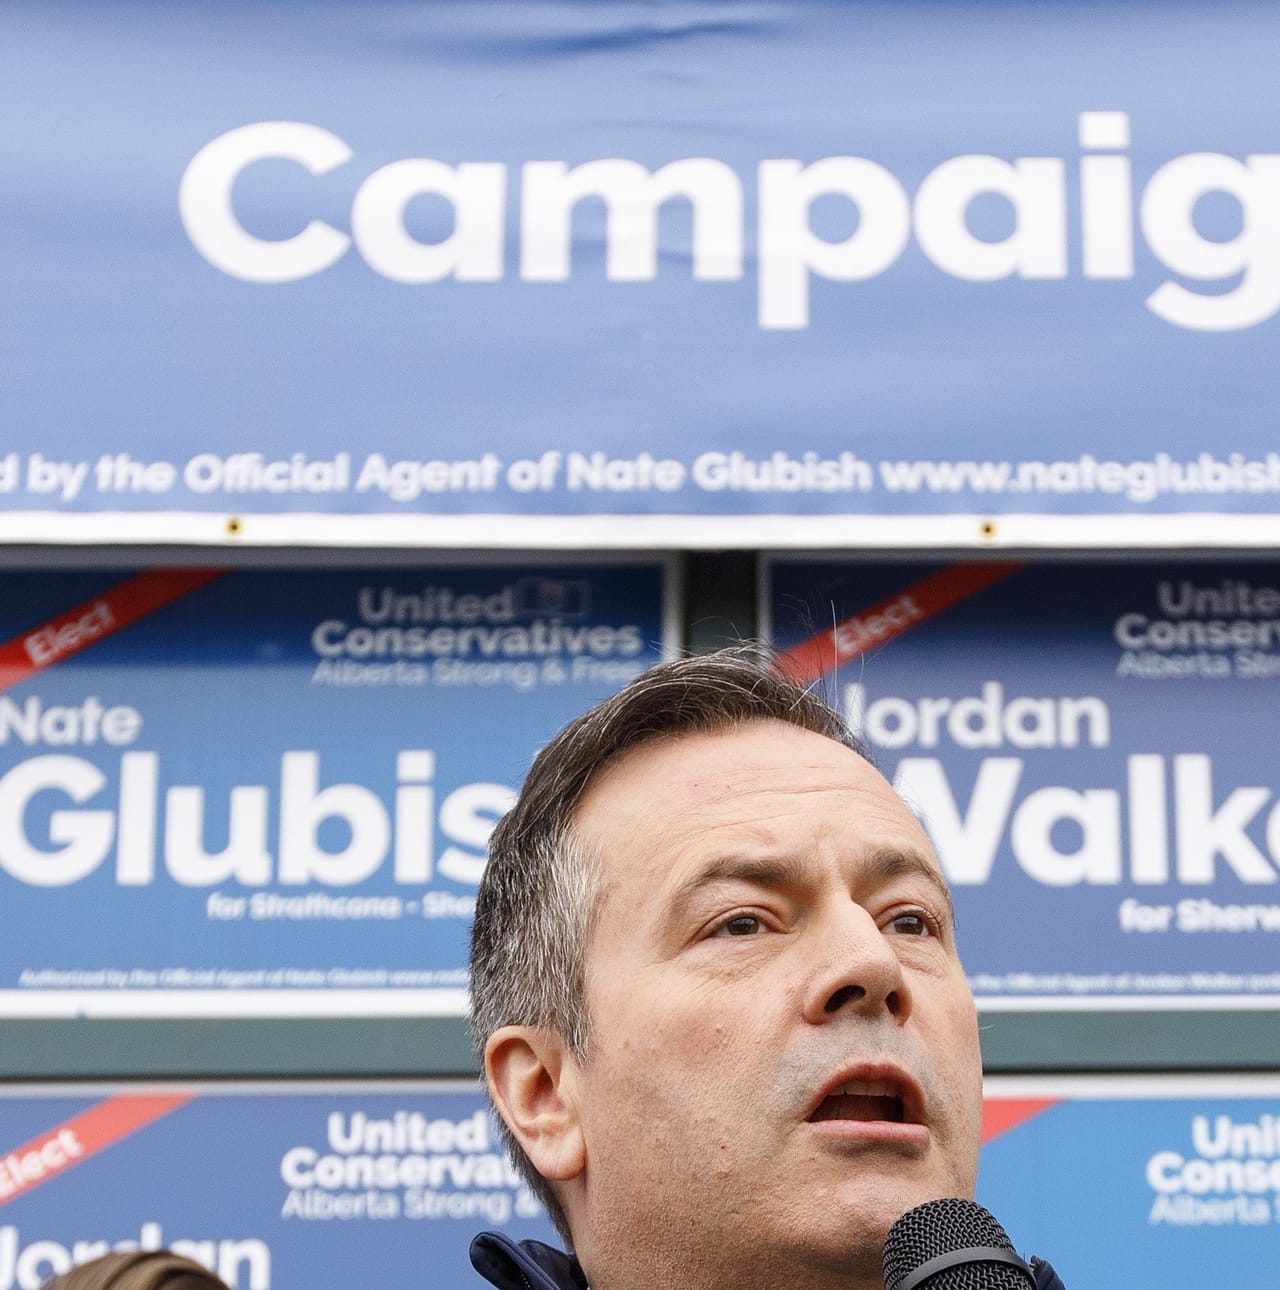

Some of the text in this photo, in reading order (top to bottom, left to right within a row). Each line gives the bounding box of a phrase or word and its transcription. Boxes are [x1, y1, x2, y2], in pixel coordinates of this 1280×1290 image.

[26, 453, 85, 501] by
[95, 453, 175, 493] the
[184, 452, 349, 493] Official
[356, 453, 499, 502] Agent
[507, 450, 560, 491] of
[567, 452, 685, 491] Nate
[692, 452, 872, 492] Glubish
[359, 587, 515, 624] United
[24, 600, 118, 669] Elect
[312, 618, 643, 657] Conservatives
[831, 594, 922, 660] Elect
[315, 656, 642, 691] Alberta Strong & Free
[1121, 649, 1228, 681] Alberta
[207, 892, 245, 919] for
[249, 892, 401, 919] Strathcona
[1119, 898, 1172, 932] for
[327, 1110, 488, 1154] United
[281, 1190, 400, 1219] Alberta
[404, 1190, 511, 1225] Strong
[1150, 1192, 1270, 1224] Alberta
